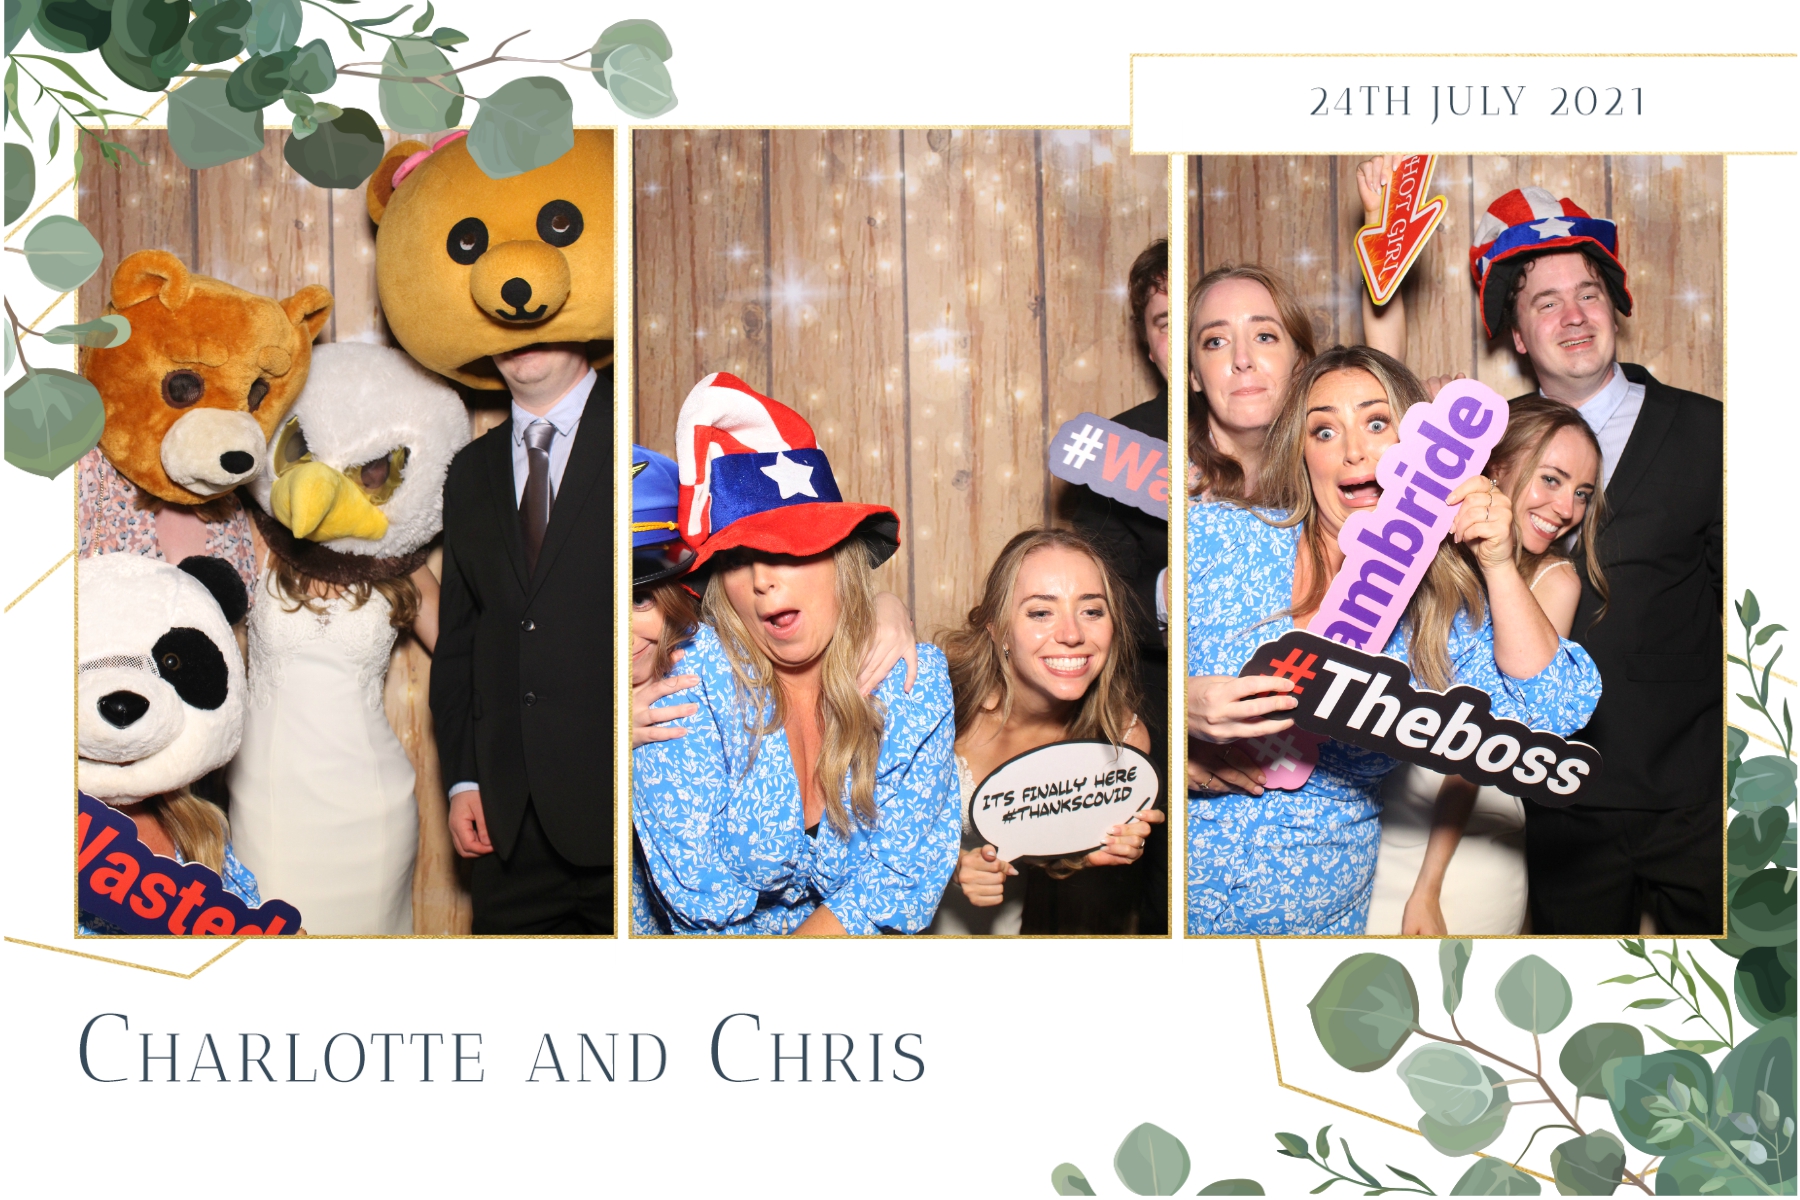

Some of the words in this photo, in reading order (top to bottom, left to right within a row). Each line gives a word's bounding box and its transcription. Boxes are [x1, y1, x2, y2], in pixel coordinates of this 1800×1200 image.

[1396, 156, 1420, 211] HOT
[1378, 218, 1407, 281] GIRL
[982, 790, 1015, 811] ITS
[1022, 776, 1087, 803] FINALLY
[1094, 766, 1138, 788] HERE
[1002, 786, 1133, 825] #THANKSCOVID
